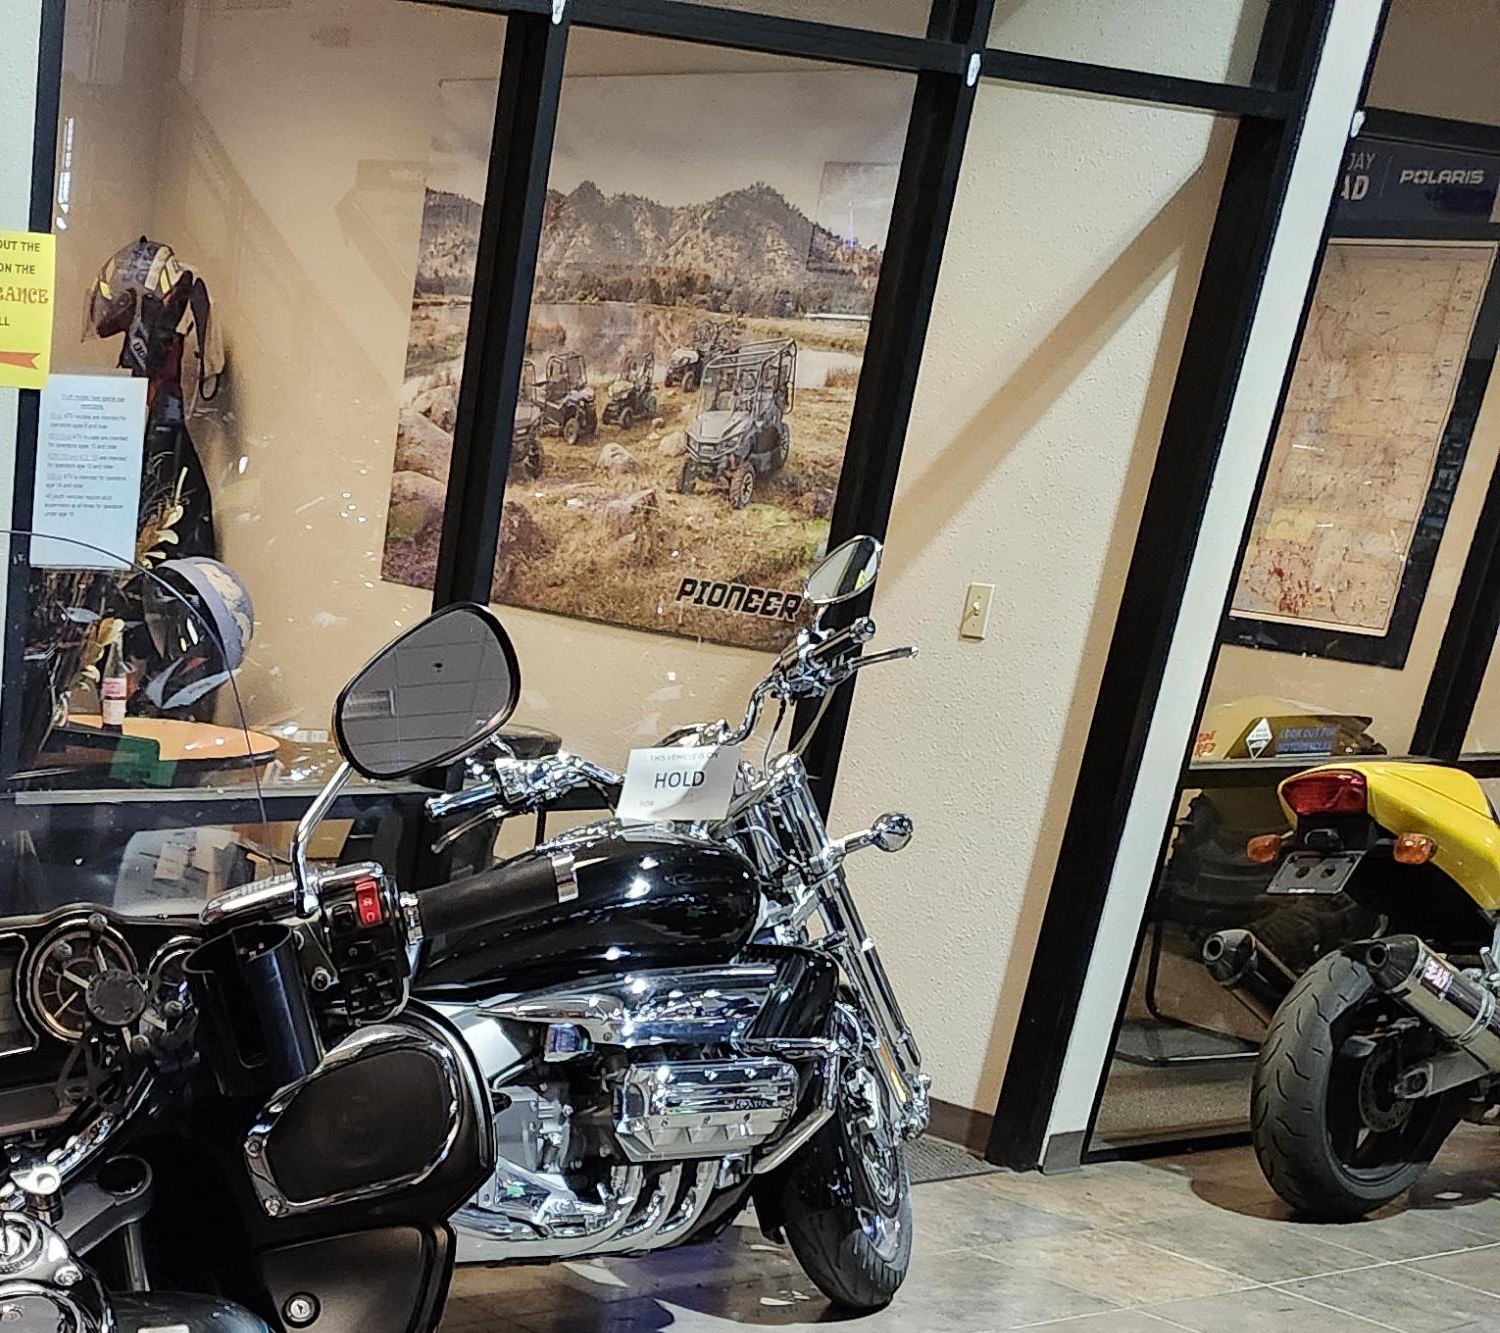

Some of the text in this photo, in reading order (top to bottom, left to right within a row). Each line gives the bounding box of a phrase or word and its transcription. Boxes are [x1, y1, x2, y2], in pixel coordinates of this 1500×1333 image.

[1399, 169, 1485, 185] POLARIS
[20, 241, 41, 252] THE
[15, 264, 36, 275] THE
[674, 577, 804, 623] PIONEER
[654, 770, 706, 789] HOLD
